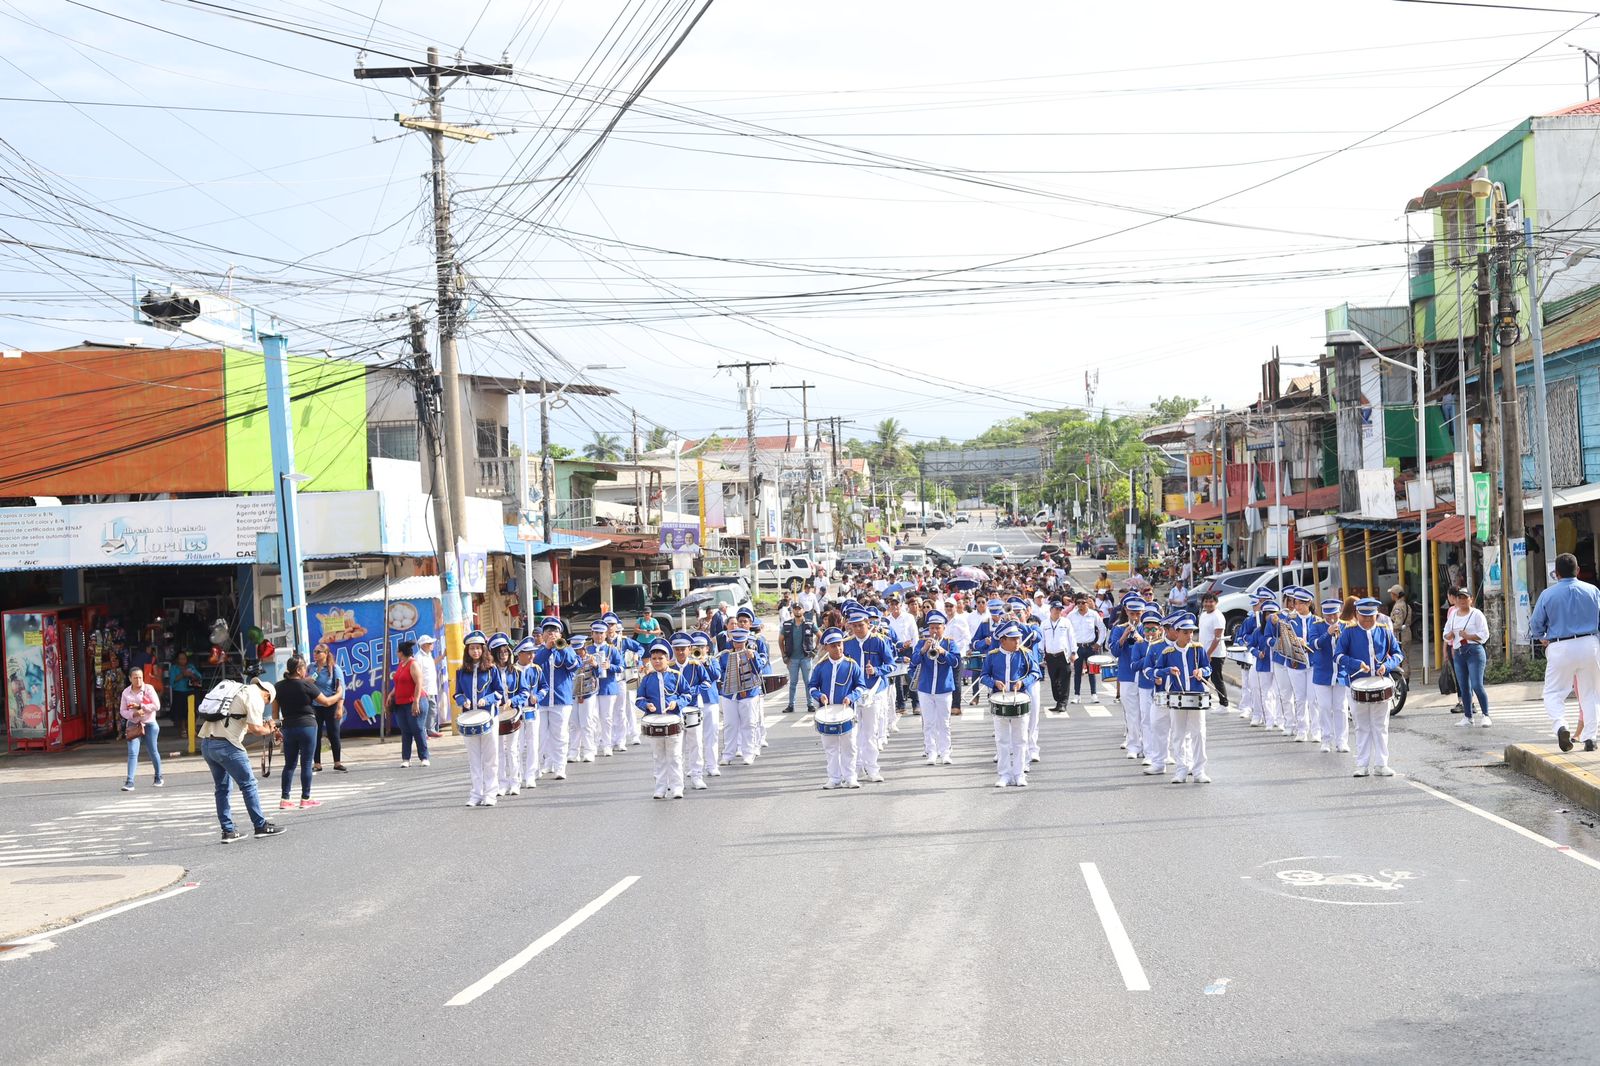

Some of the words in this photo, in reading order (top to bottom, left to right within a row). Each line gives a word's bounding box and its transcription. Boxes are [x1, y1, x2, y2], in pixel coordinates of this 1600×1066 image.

[119, 532, 208, 555] Morales
[704, 560, 737, 569] OTEL
[335, 630, 420, 677] ASETA
